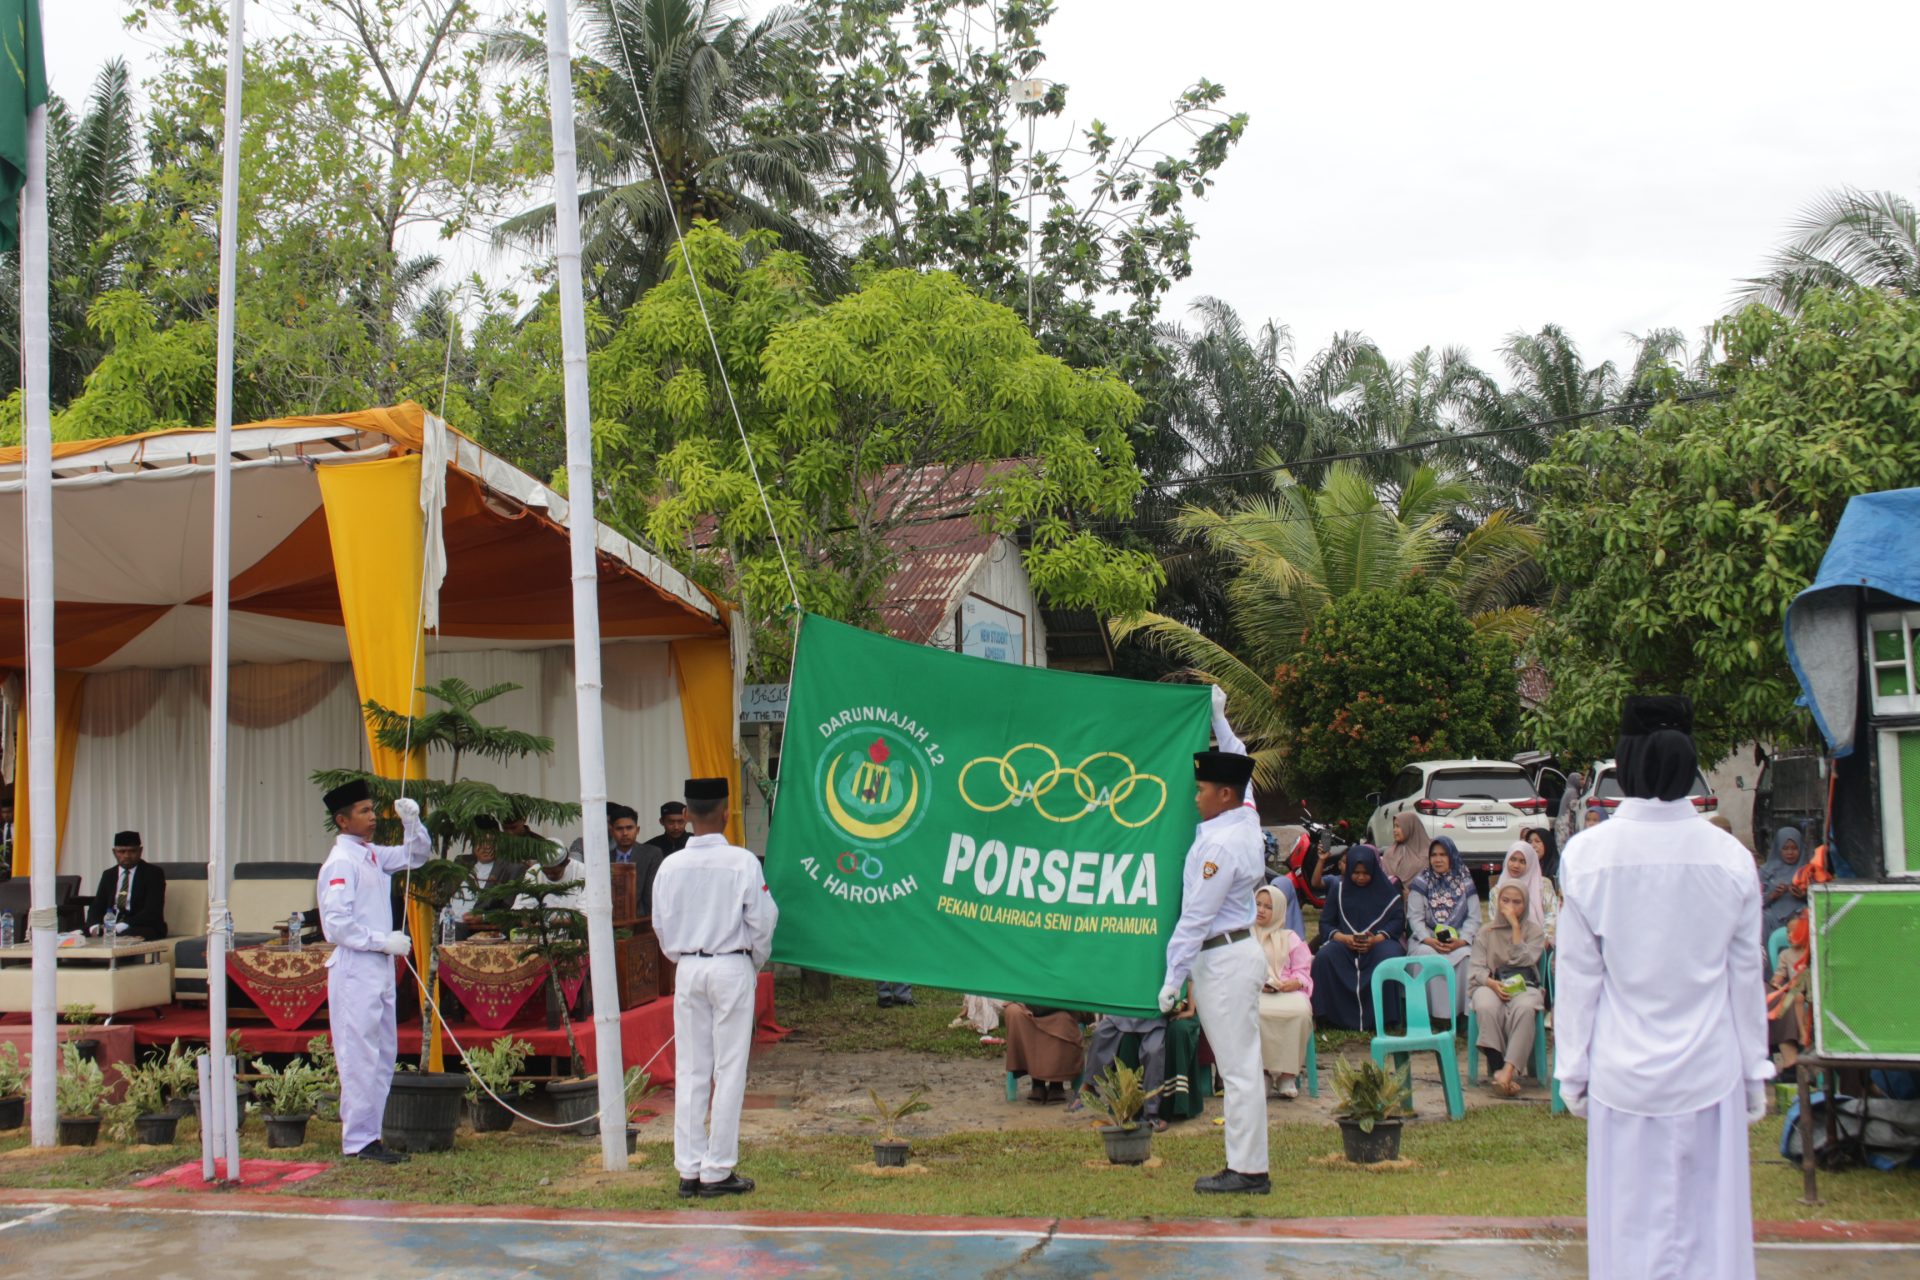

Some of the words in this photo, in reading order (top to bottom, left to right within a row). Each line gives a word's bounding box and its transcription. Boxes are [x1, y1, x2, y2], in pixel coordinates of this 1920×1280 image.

[753, 711, 770, 720] THE
[819, 706, 929, 743] DARUNNAJAH
[925, 743, 945, 767] 12
[800, 856, 820, 880] AL
[823, 873, 918, 904] HAROKAH
[942, 832, 1157, 905] PORSEKA
[937, 895, 978, 919] PEKAN
[980, 904, 1042, 928] OLAHRAGA
[1044, 913, 1071, 931] SENI
[1074, 916, 1098, 933] DAN
[1101, 916, 1158, 935] PRAMUKA
